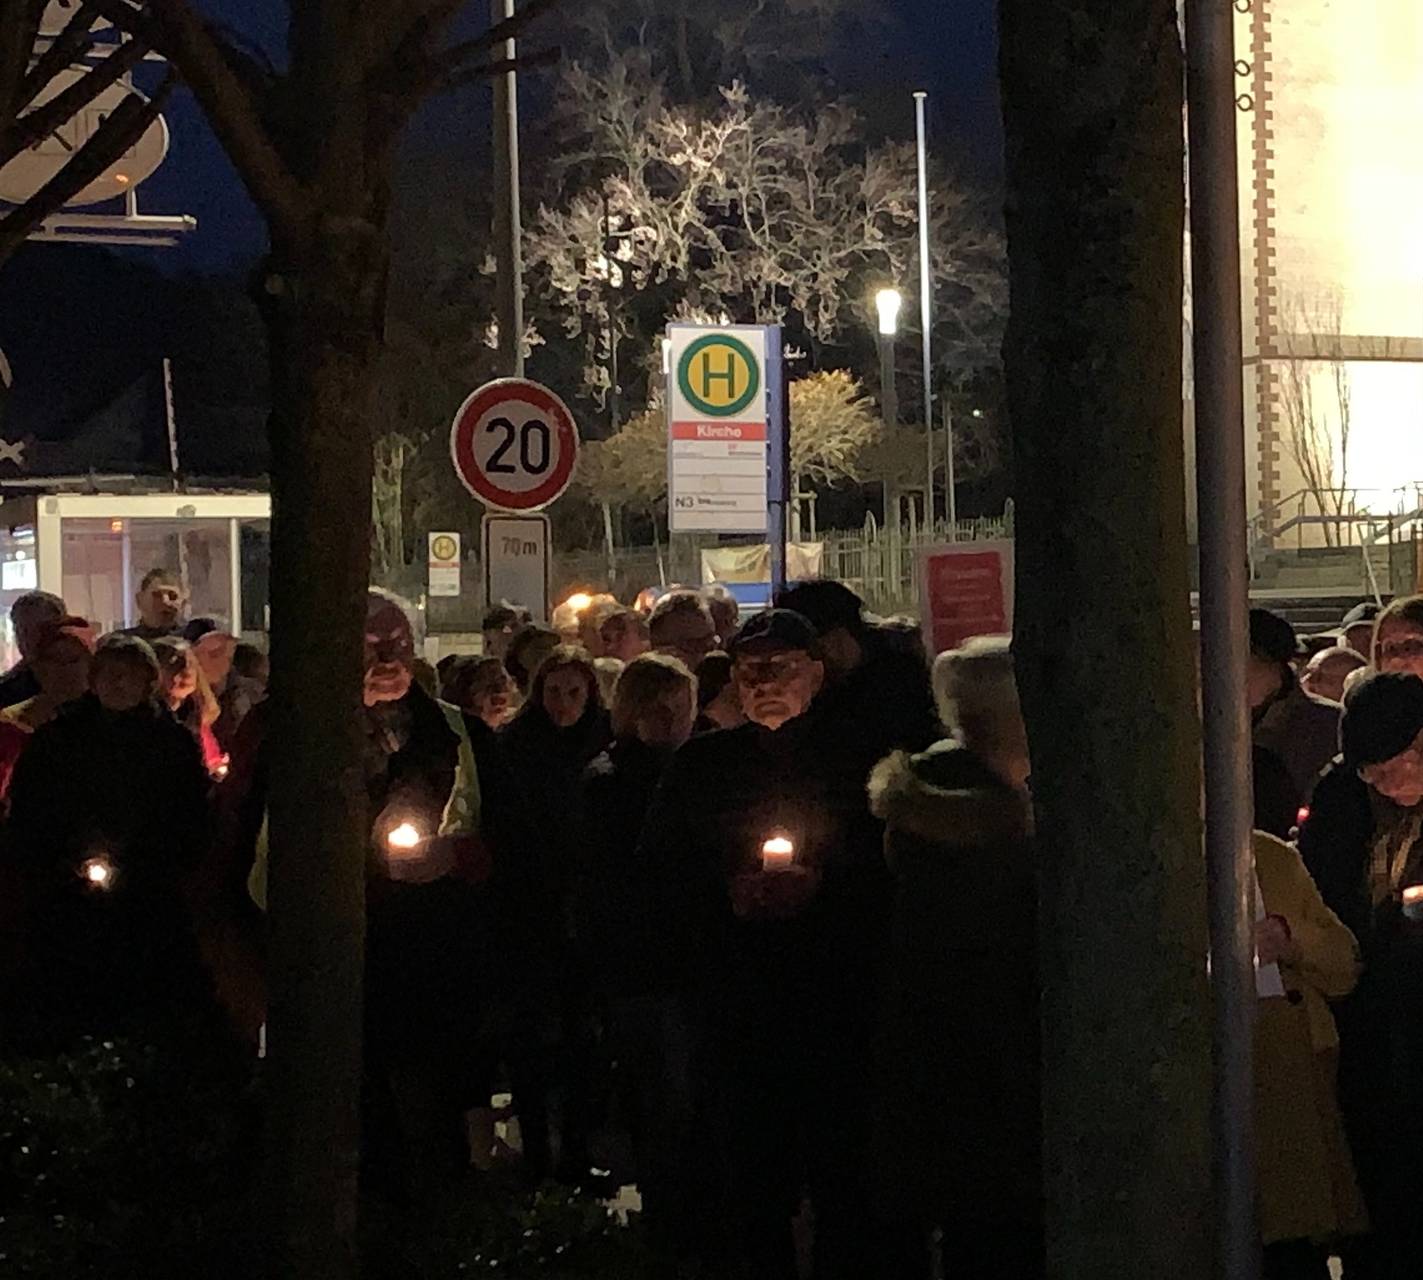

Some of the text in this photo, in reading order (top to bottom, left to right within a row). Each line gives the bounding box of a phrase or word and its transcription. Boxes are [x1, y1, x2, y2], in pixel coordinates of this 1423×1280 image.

[702, 353, 735, 398] H
[697, 424, 742, 438] Kirche
[485, 417, 550, 475] 20
[675, 496, 694, 508] N3
